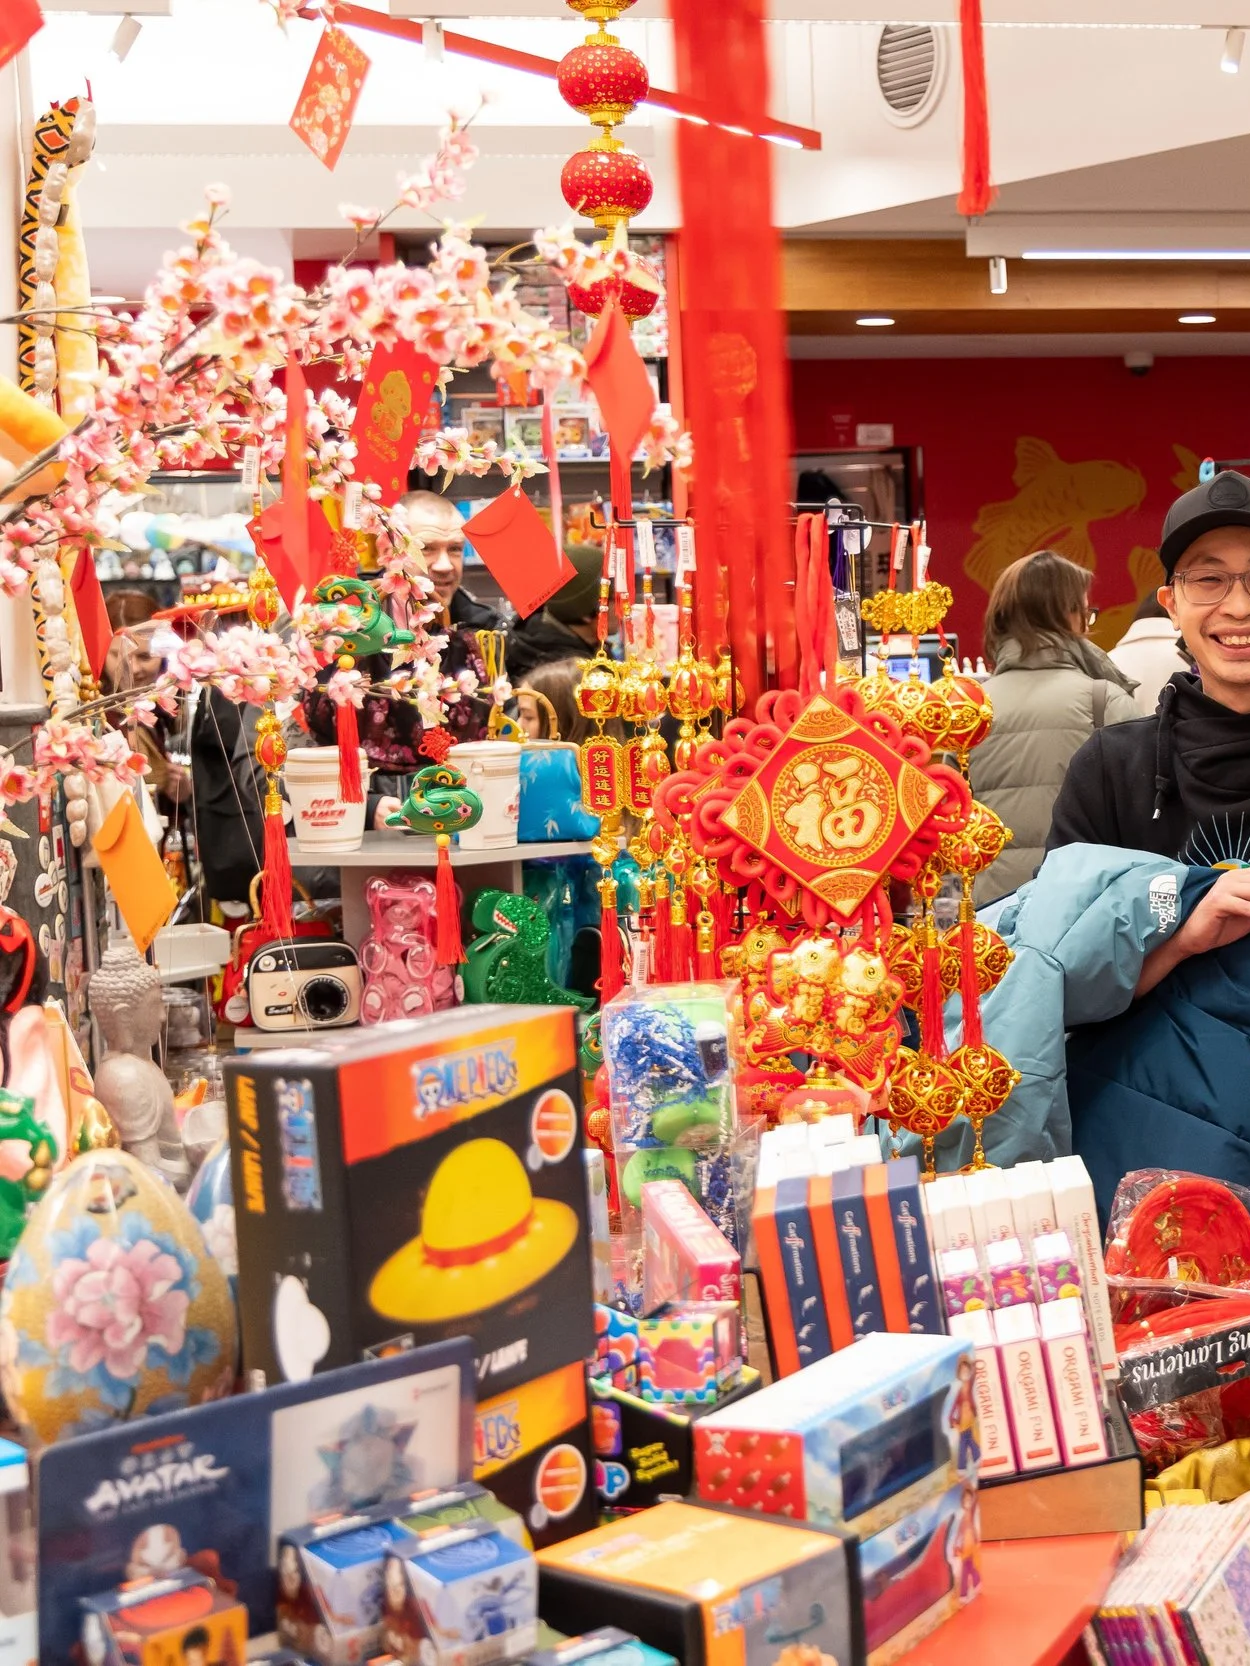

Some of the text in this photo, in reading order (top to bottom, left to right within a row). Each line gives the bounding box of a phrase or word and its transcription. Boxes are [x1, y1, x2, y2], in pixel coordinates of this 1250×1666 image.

[784, 755, 882, 851] 福
[1149, 892, 1159, 914] THE
[1158, 893, 1168, 933] NORTH
[1167, 894, 1177, 923] FACE
[1092, 1292, 1102, 1313] NOTE
[1095, 1316, 1106, 1342] CARDS
[1132, 1341, 1224, 1384] Lanterns
[975, 1359, 999, 1450] ORIGAMI FUN
[1018, 1351, 1044, 1442] ORIGAMI FUN
[1063, 1346, 1090, 1437] ORIGAMI FUN
[474, 1402, 521, 1466] IECE
[85, 1453, 230, 1514] AVATAR
